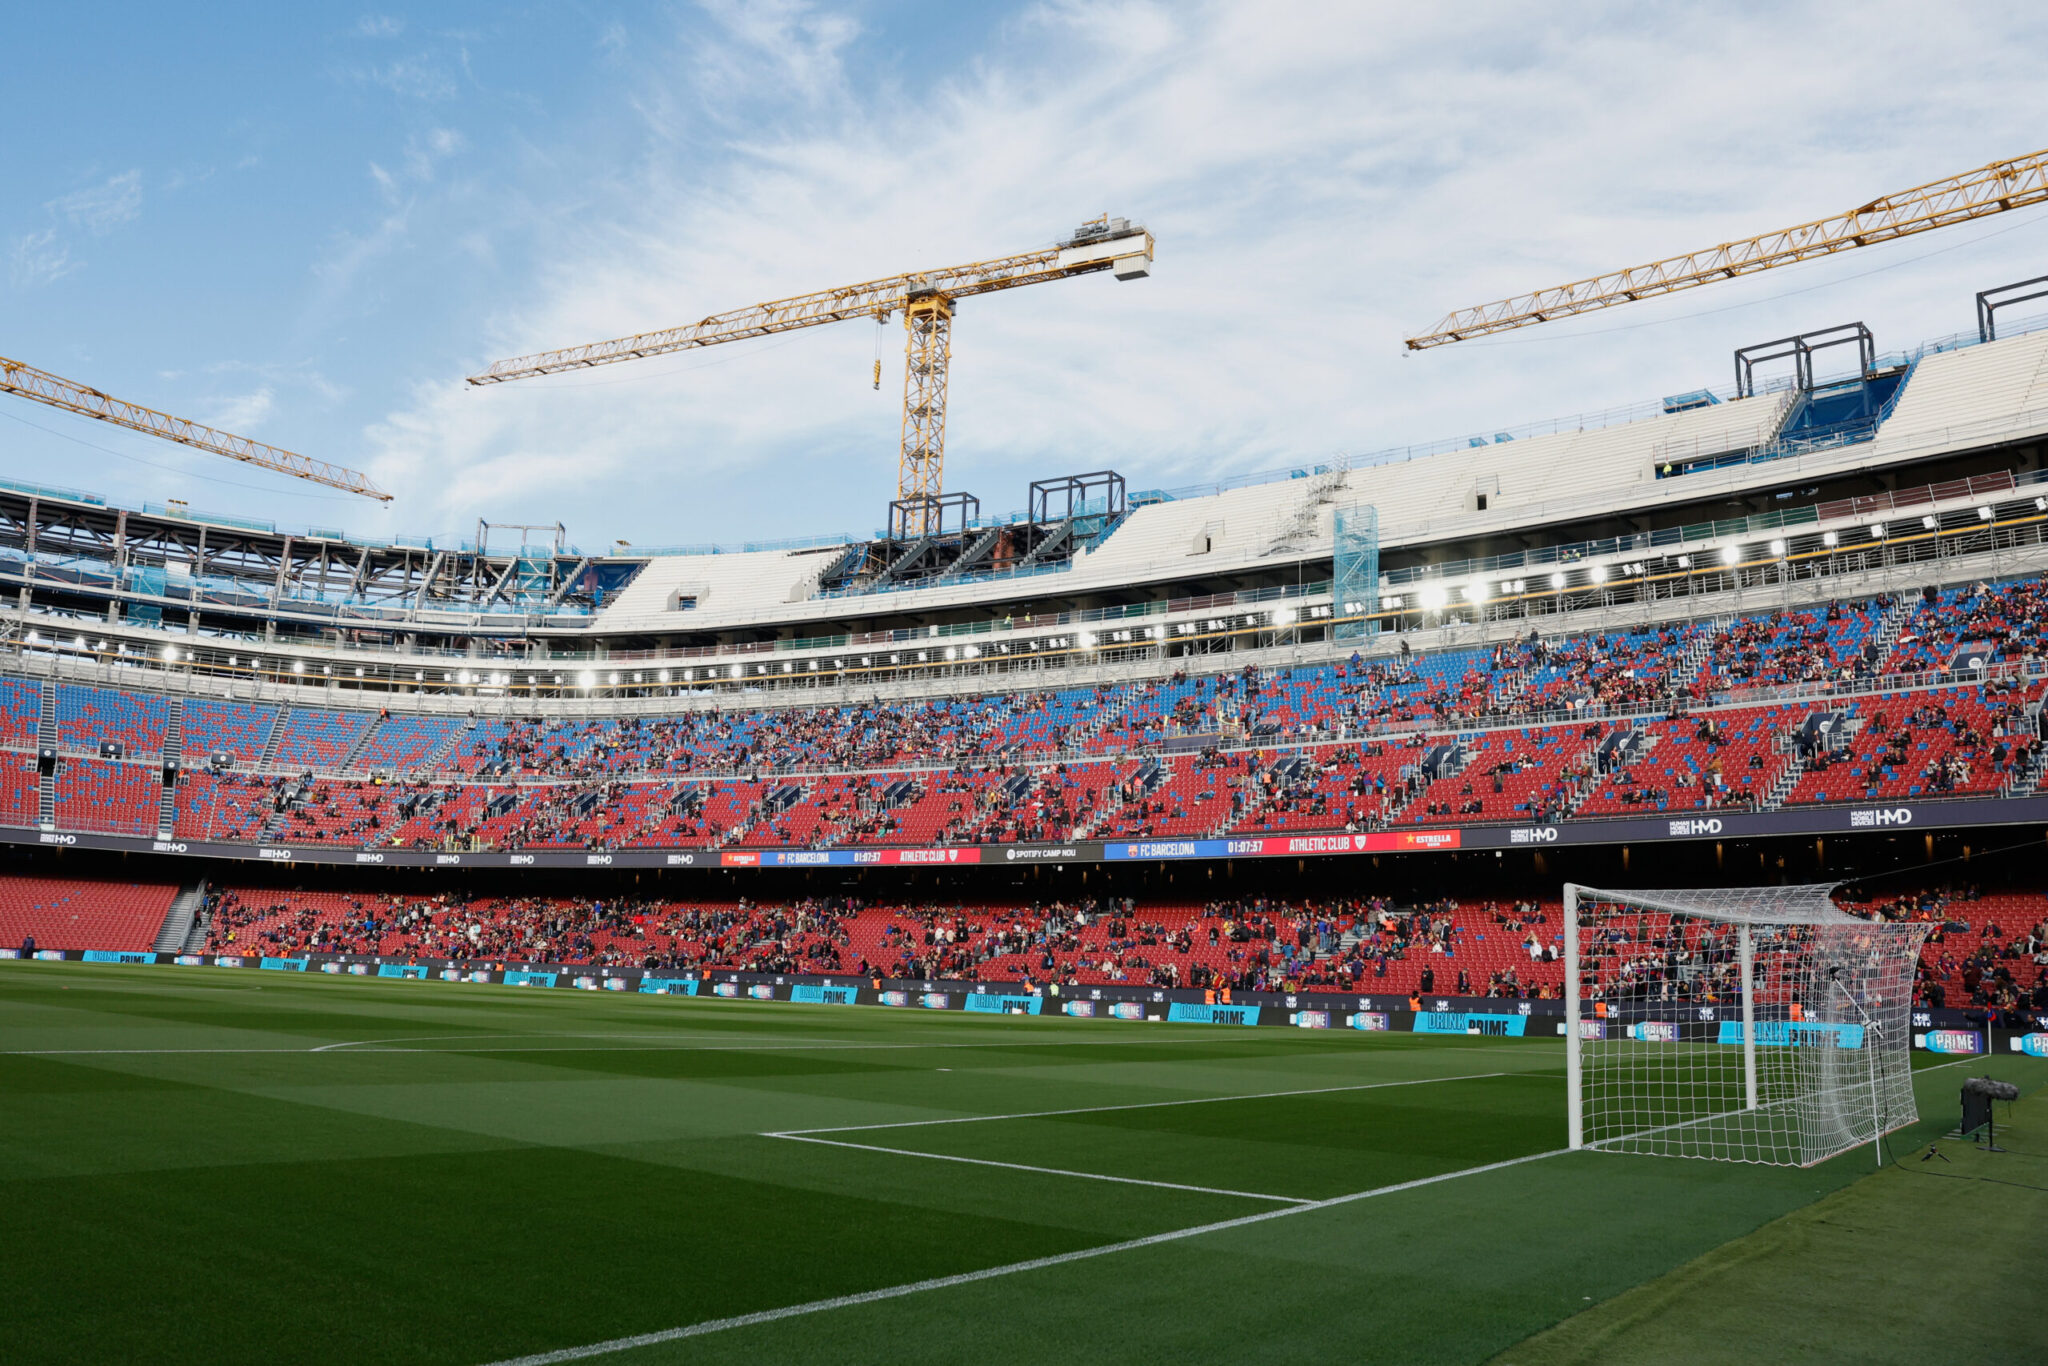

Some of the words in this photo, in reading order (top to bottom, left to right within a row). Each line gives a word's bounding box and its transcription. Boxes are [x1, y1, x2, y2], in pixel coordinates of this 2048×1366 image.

[1876, 808, 1912, 825] HMD
[1691, 819, 1722, 834] HMD
[55, 835, 76, 845] HMD
[1416, 835, 1451, 843] ESTRELLA
[1530, 828, 1557, 841] HMD
[167, 843, 187, 852] HMD
[1141, 845, 1150, 856] FC
[1151, 843, 1195, 856] BARCELONA
[1290, 838, 1326, 851] ATHLETIC
[1327, 836, 1350, 850] CLUB
[273, 850, 291, 859] HMD
[367, 854, 383, 862] HMD
[597, 855, 612, 864] HMD
[678, 855, 693, 864] HMD
[787, 853, 794, 864] FC
[795, 852, 829, 863] BARCELONA
[900, 851, 927, 862] ATHLETIC
[928, 850, 945, 861] CLUB
[1016, 850, 1042, 859] SPOTIFY
[1043, 849, 1060, 858] CAMP
[1062, 848, 1076, 857] NOU
[120, 955, 145, 964] PRIME
[668, 984, 689, 995] PRIME
[823, 991, 847, 1004] PRIME
[887, 992, 905, 1004] PRIME
[928, 994, 946, 1007] PRIME
[975, 994, 1001, 1009] DRINK
[1071, 1001, 1092, 1015] PRIME
[1119, 1004, 1141, 1017] PRIME
[1180, 1004, 1210, 1019] DRINK
[1212, 1011, 1245, 1025] PRIME
[1301, 1013, 1326, 1027] PRIME
[1428, 1012, 1466, 1030] DRINK
[1468, 1020, 1509, 1036] PRIME
[1579, 1022, 1601, 1037] RIME
[1643, 1025, 1673, 1039] PRIME
[1936, 1033, 1974, 1051] PRIME
